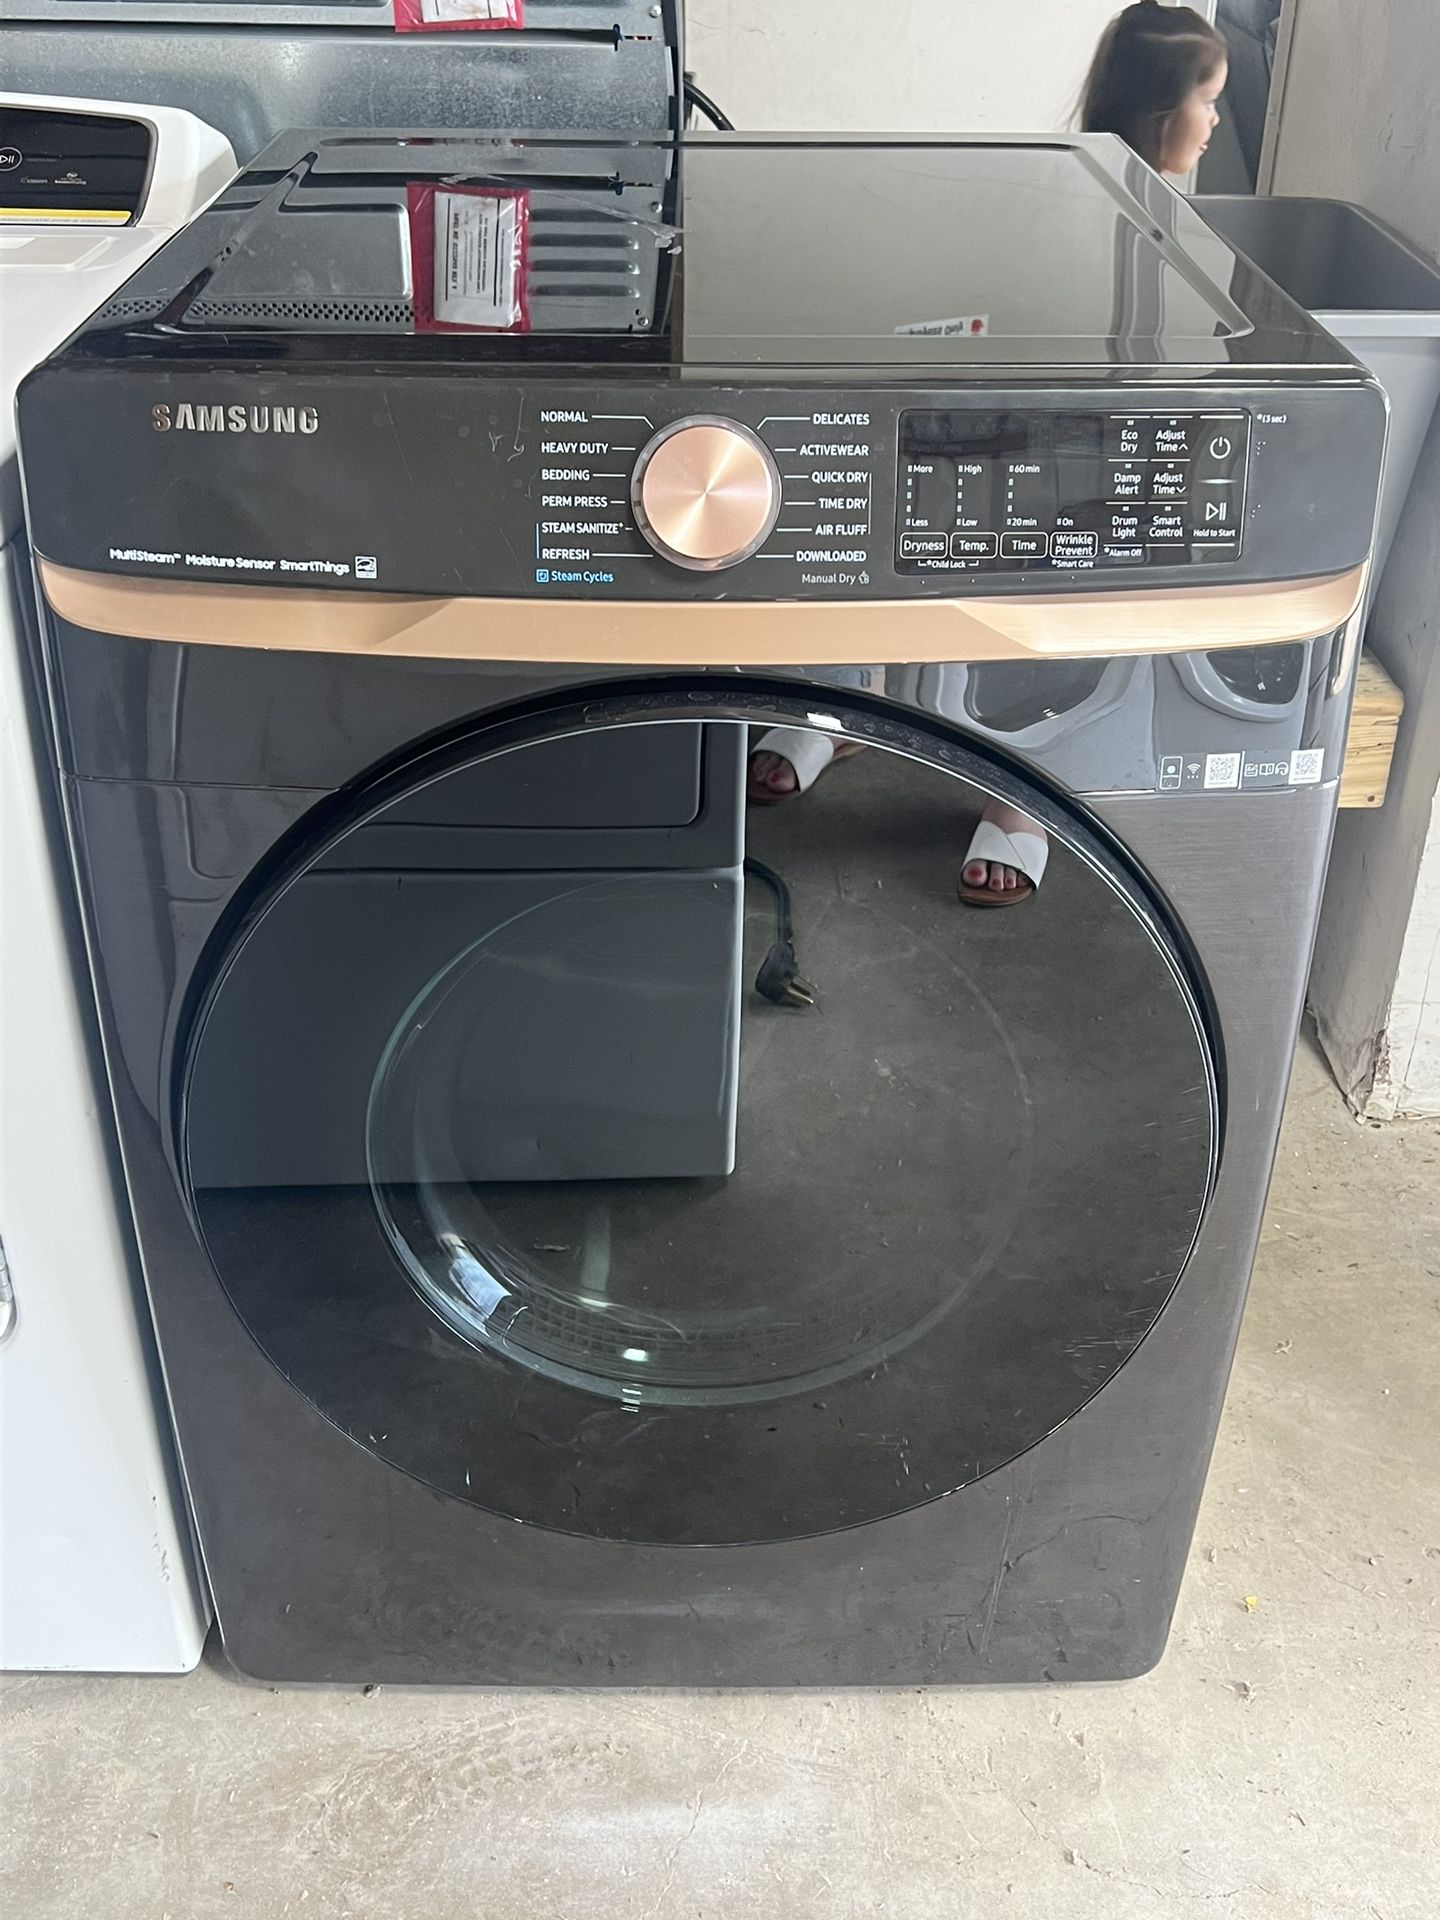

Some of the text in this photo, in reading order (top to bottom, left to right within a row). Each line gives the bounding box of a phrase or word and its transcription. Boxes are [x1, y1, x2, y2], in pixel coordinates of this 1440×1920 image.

[152, 404, 319, 434] SAMSUNG
[541, 411, 588, 422] NORMAL
[813, 413, 869, 425] DELICATES
[1121, 430, 1137, 440] Eco
[1156, 430, 1186, 441] Adjust
[541, 442, 608, 454] HEAVY DUTY
[800, 444, 869, 456] ACTIVEWEAR
[1120, 442, 1137, 453] Dry
[1155, 442, 1178, 452] Time
[913, 464, 933, 474] More
[964, 464, 982, 475] High
[1014, 464, 1040, 474] 60 min
[542, 469, 590, 481] BEDDING
[812, 472, 867, 483] QUICK DRY
[1114, 473, 1141, 486] Damp
[1154, 473, 1183, 484] Adjust
[1114, 484, 1138, 495] Alert
[1153, 484, 1176, 495] Time
[542, 496, 608, 508] PERM PRESS
[819, 498, 867, 509] TIME DRY
[911, 518, 928, 527] Less
[962, 518, 978, 527] Low
[1012, 518, 1037, 527] 20 min
[1062, 517, 1074, 526] On
[1112, 516, 1138, 527] Drum
[1152, 515, 1181, 526] Smart
[542, 522, 575, 534] STEAM
[815, 524, 867, 536] AIR FLUFF
[1112, 527, 1136, 539] Light
[1149, 527, 1183, 538] Control
[1193, 528, 1235, 537] Hold to Start
[1056, 534, 1093, 545] Wrinkle
[903, 539, 945, 553] Dryness
[959, 540, 989, 553] Temp.
[1012, 540, 1036, 551] Time
[1055, 544, 1093, 556] Prevent
[542, 549, 590, 560] REFRESH
[796, 551, 866, 562] DOWNLOADED
[1132, 547, 1142, 557] Off
[186, 554, 234, 568] Moisture
[236, 556, 275, 570] Sensor
[280, 560, 350, 576] SmartThings
[949, 560, 966, 569] Lock
[1077, 559, 1093, 568] Care
[551, 571, 613, 584] Steam Cycles
[802, 572, 856, 586] Manual Dry
